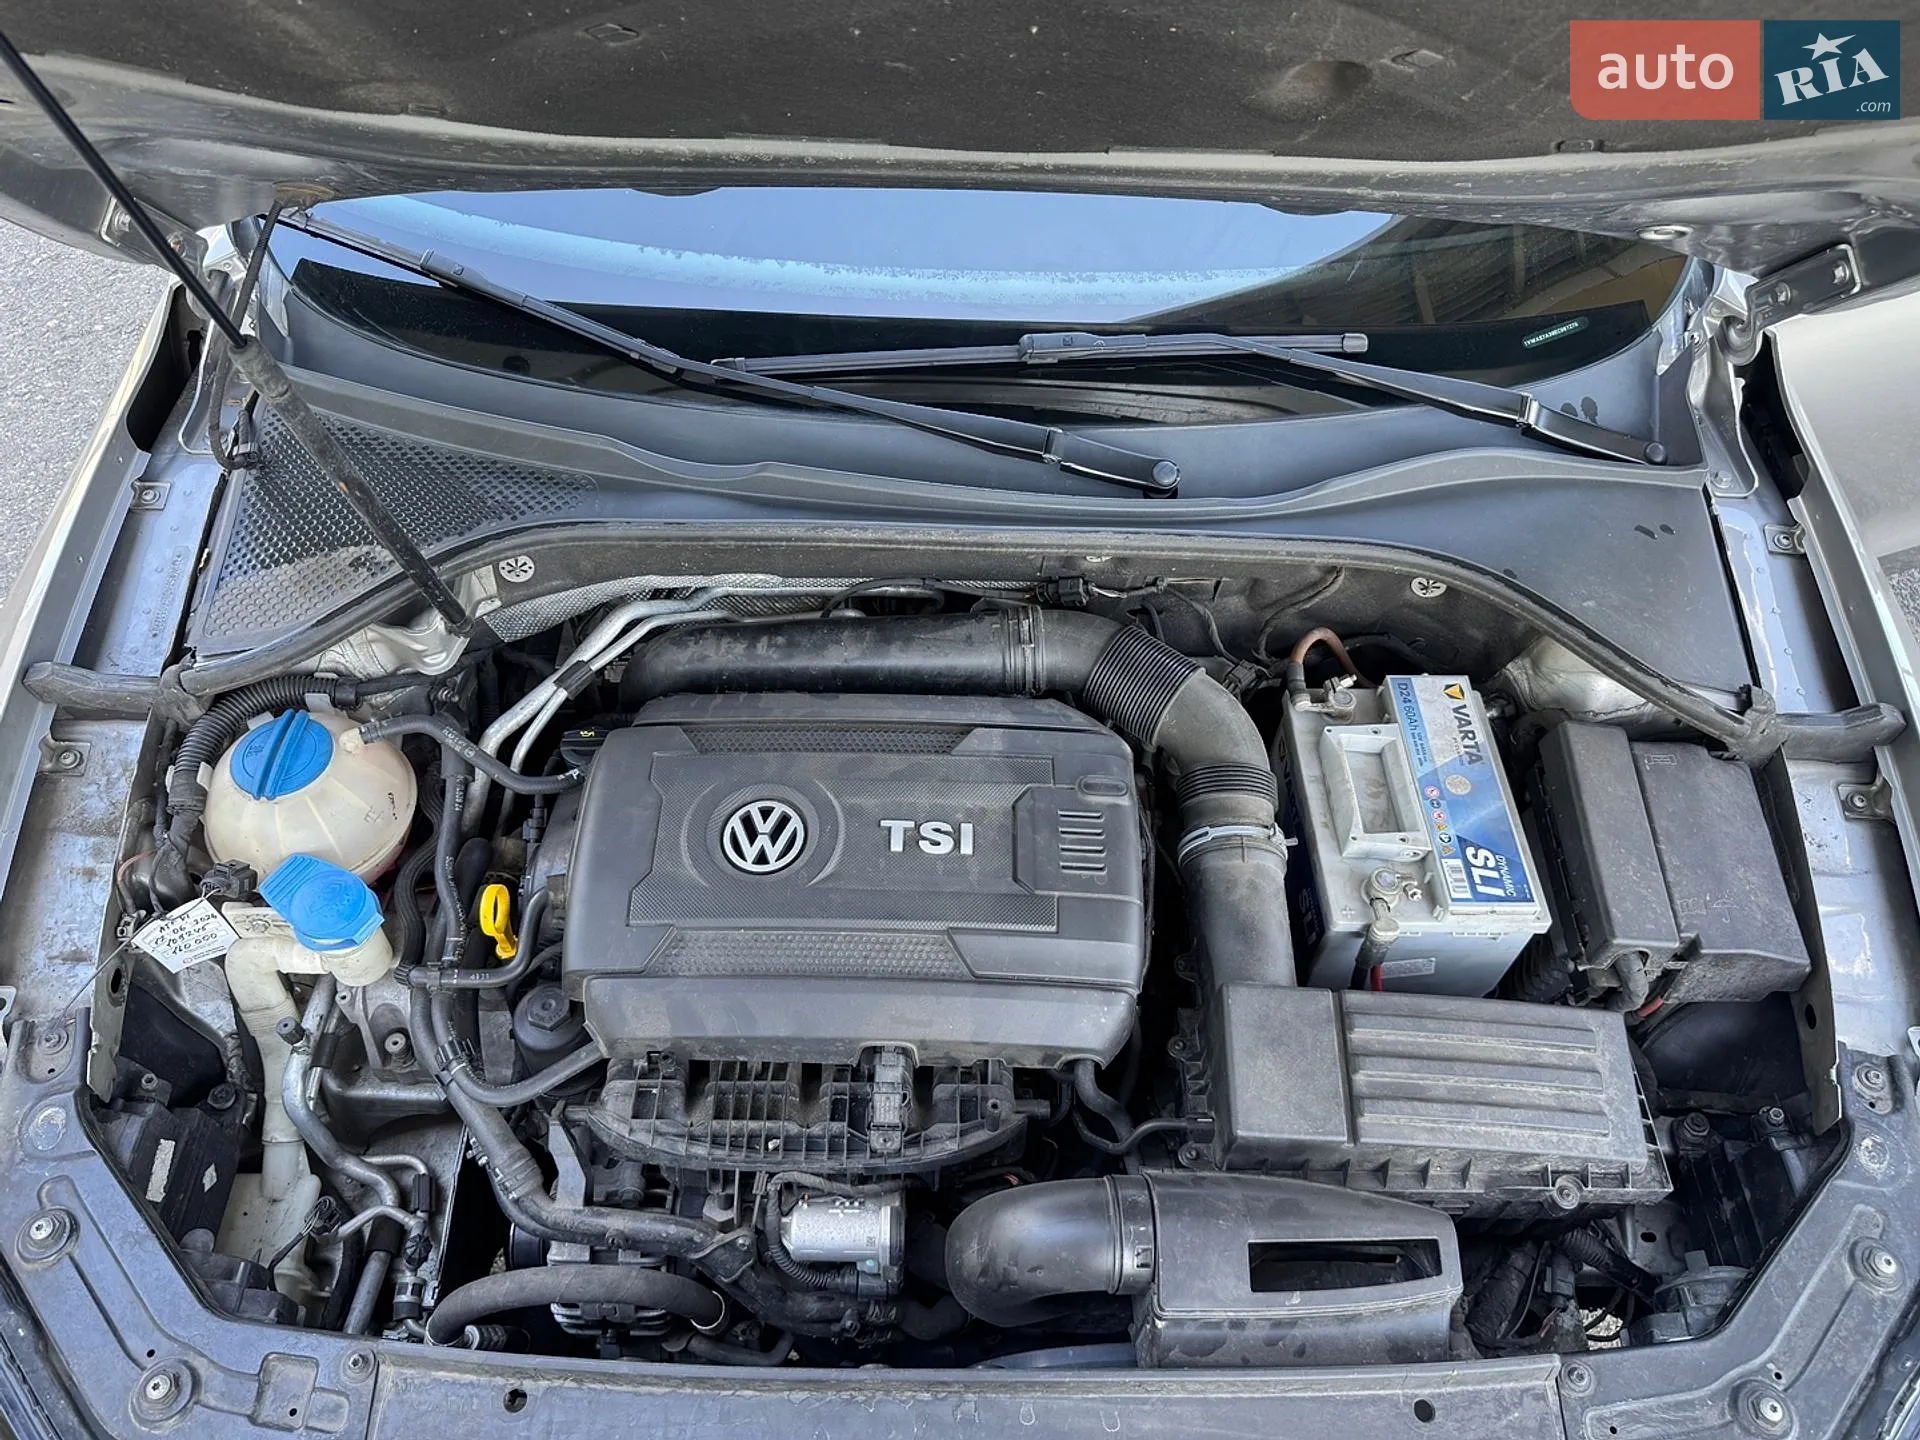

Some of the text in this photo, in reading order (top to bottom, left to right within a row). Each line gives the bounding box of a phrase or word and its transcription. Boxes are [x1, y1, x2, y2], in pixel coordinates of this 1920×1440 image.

[1397, 682, 1411, 704] D24
[1403, 705, 1419, 731] 60Ah
[1452, 703, 1484, 765] VARTA
[880, 819, 974, 855] TSI
[1465, 845, 1506, 897] SLI
[1495, 854, 1516, 897] DYNAMIC
